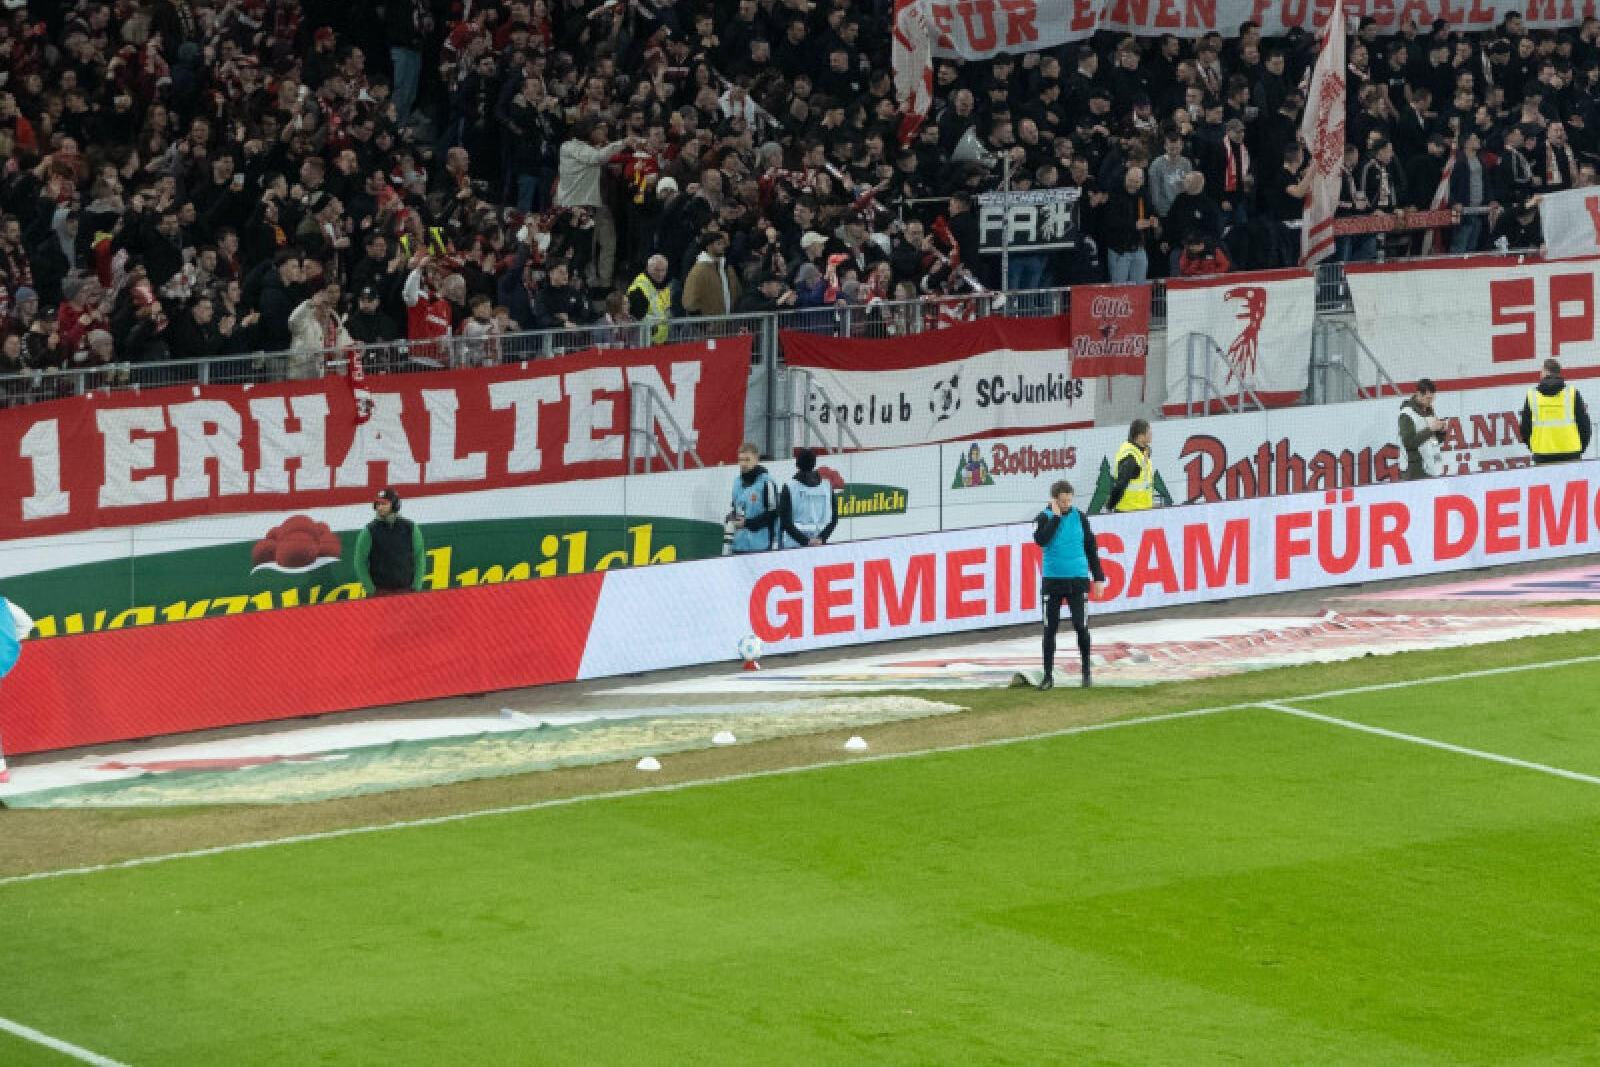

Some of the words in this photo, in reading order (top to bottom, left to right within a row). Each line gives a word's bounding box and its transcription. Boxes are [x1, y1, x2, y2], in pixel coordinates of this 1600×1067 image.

[976, 373, 1083, 408] SC-Junkies
[20, 418, 70, 520] 1
[95, 360, 701, 509] ERHALTEN
[1438, 411, 1526, 451] ANN
[989, 443, 1077, 478] Rothaus
[1178, 434, 1401, 504] Rothaus
[1274, 489, 1413, 580] FÜR
